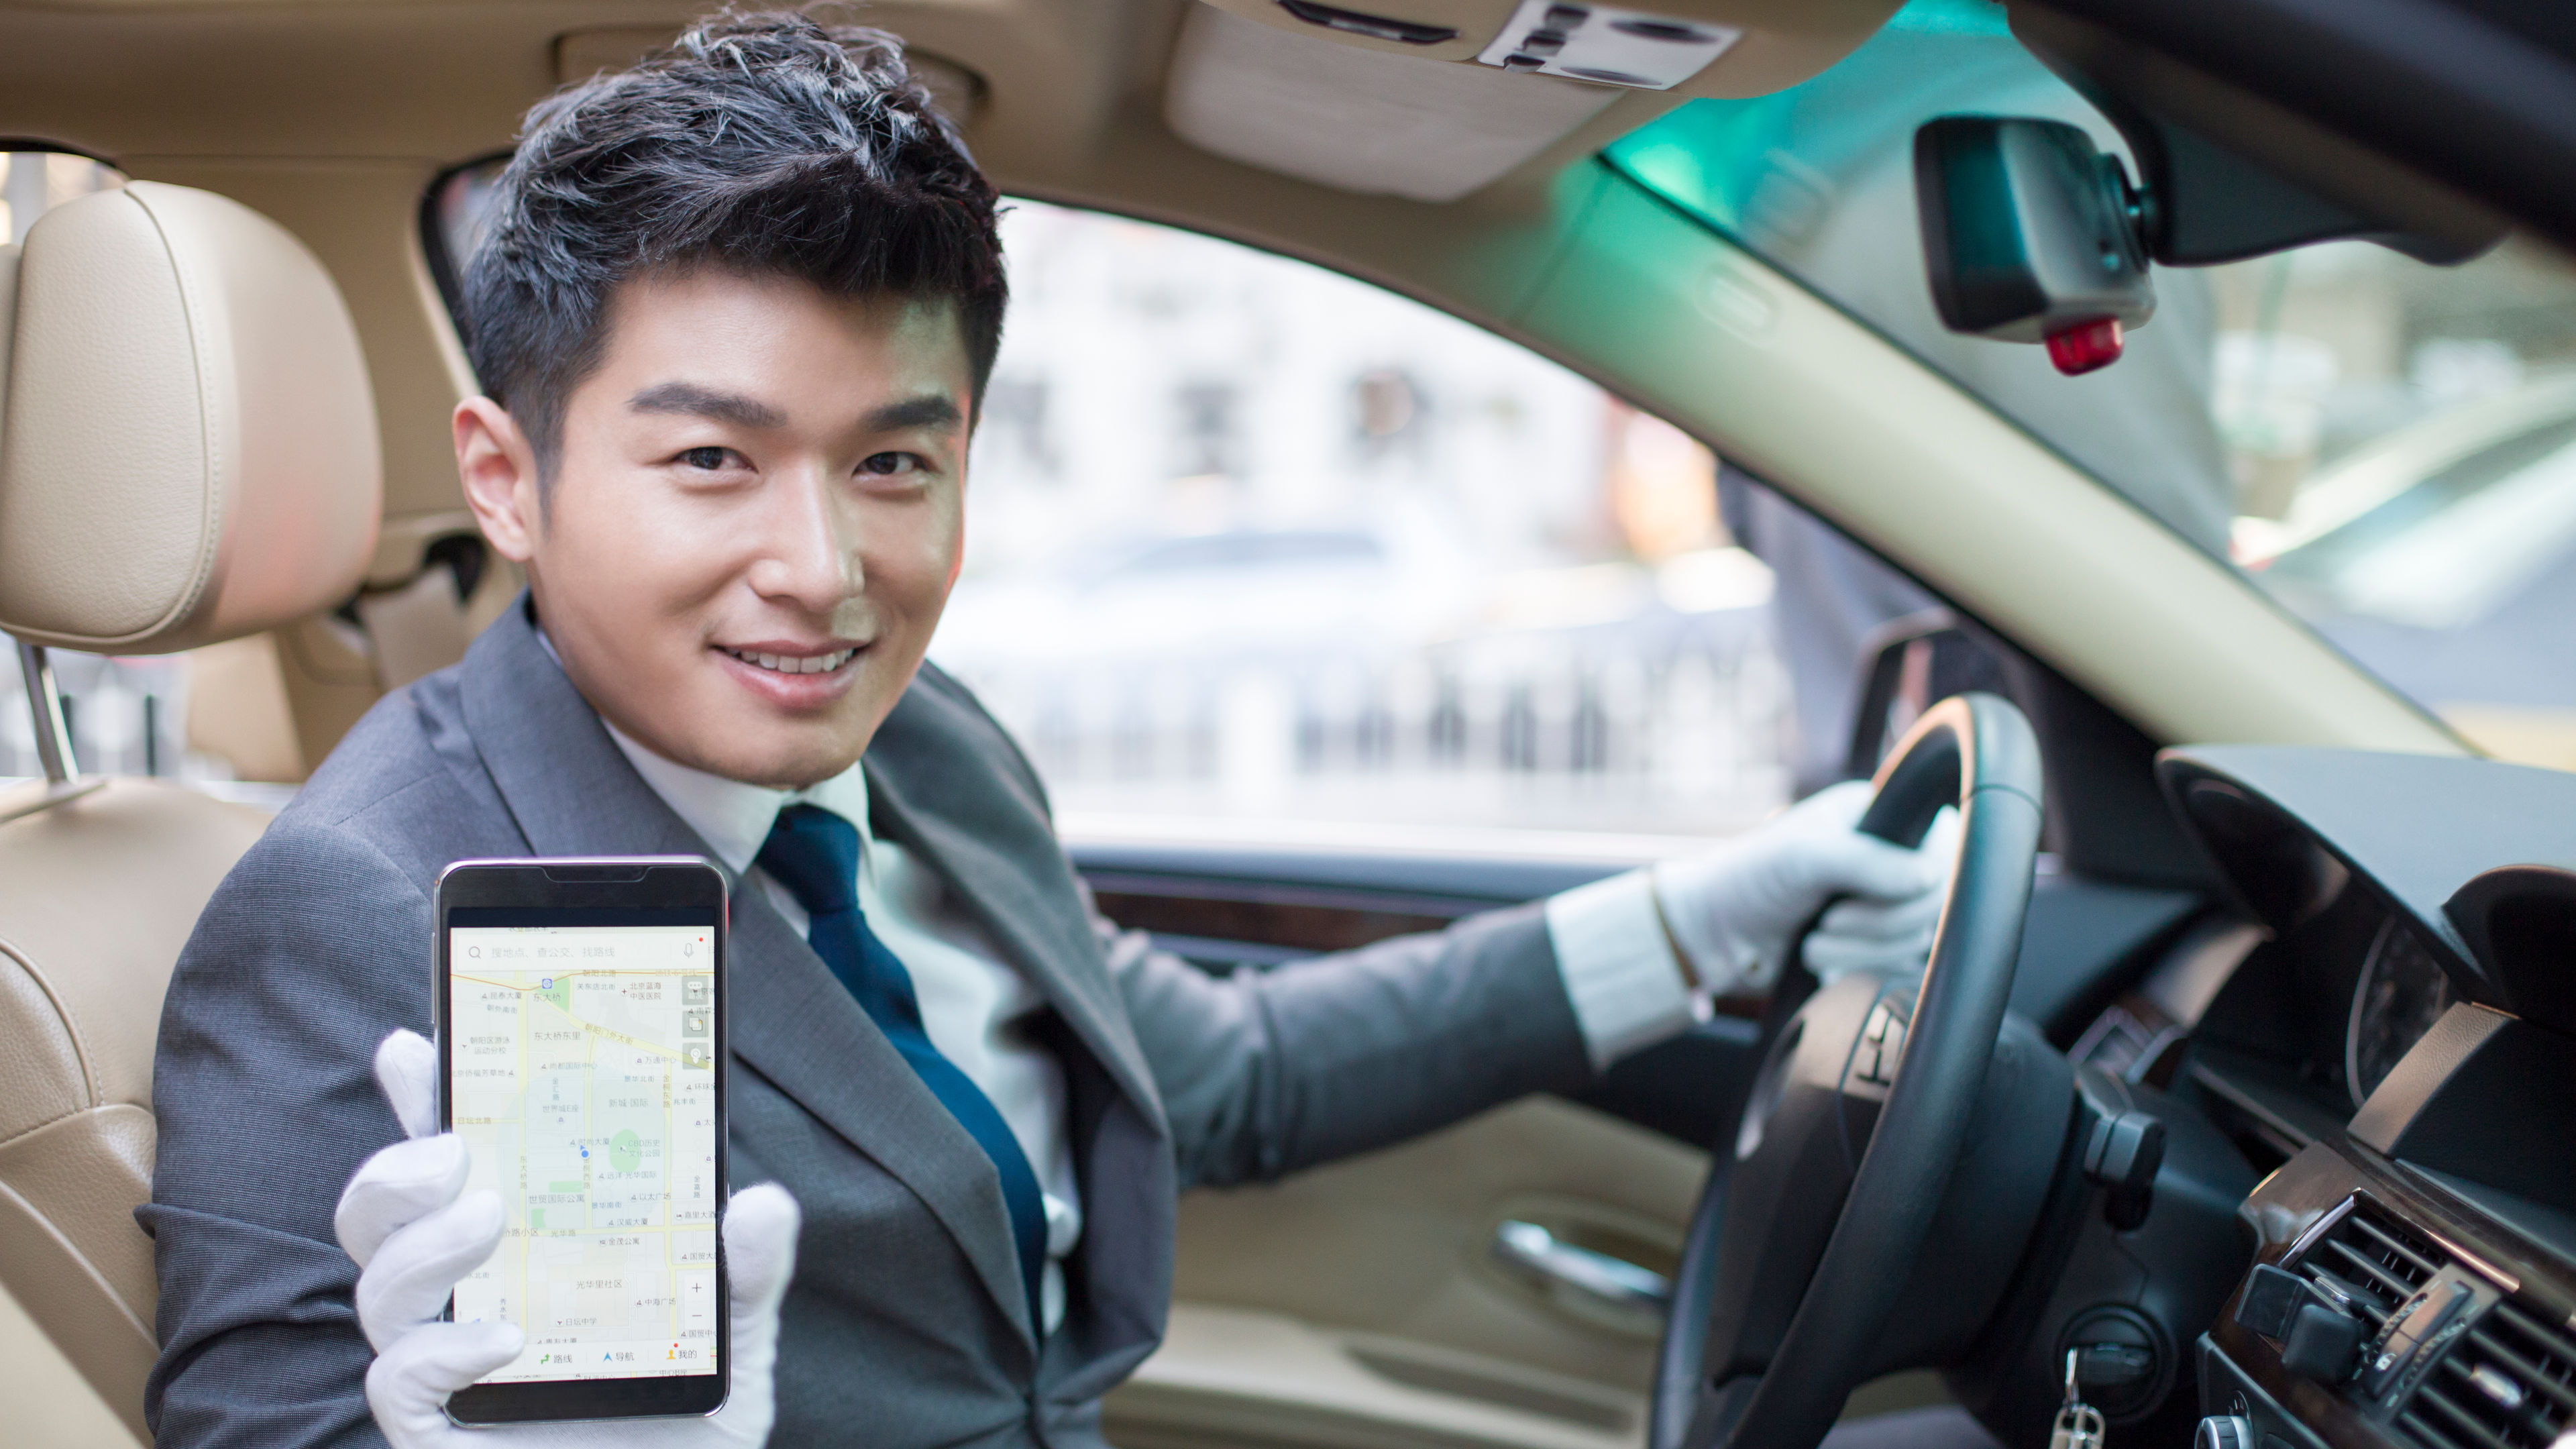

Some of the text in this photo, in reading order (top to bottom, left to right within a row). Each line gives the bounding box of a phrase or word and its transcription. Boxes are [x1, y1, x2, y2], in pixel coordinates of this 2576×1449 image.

[533, 992, 561, 1002] 东大桥
[534, 1031, 581, 1041] 东大桥东里
[645, 1056, 677, 1065] 万通中心
[529, 1194, 585, 1204] 世贸国际公寓
[689, 1252, 716, 1260] 国贸大
[576, 1279, 623, 1289] 光华里社区
[645, 1297, 677, 1305] 中海广场
[566, 1318, 597, 1326] 日坛中学
[553, 1354, 573, 1364] 路线
[615, 1352, 635, 1362] 导航
[678, 1350, 698, 1359] 我的
